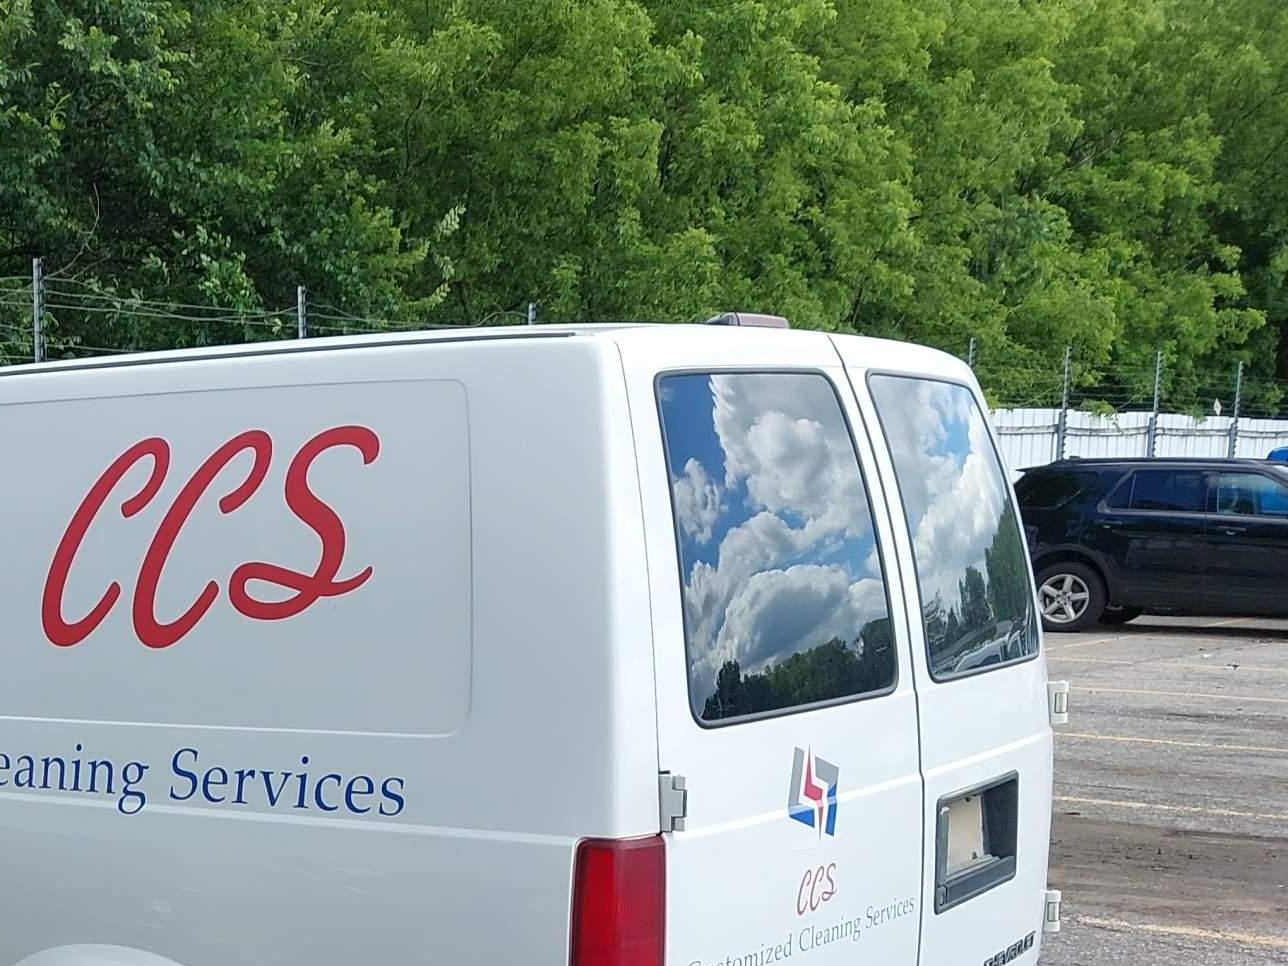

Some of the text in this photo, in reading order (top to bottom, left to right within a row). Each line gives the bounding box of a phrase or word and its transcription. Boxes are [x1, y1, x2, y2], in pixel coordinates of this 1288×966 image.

[41, 424, 380, 650] CCS
[168, 748, 407, 817] Services
[796, 862, 838, 916] CCS
[798, 914, 862, 953] Cleaning
[864, 896, 915, 930] Services
